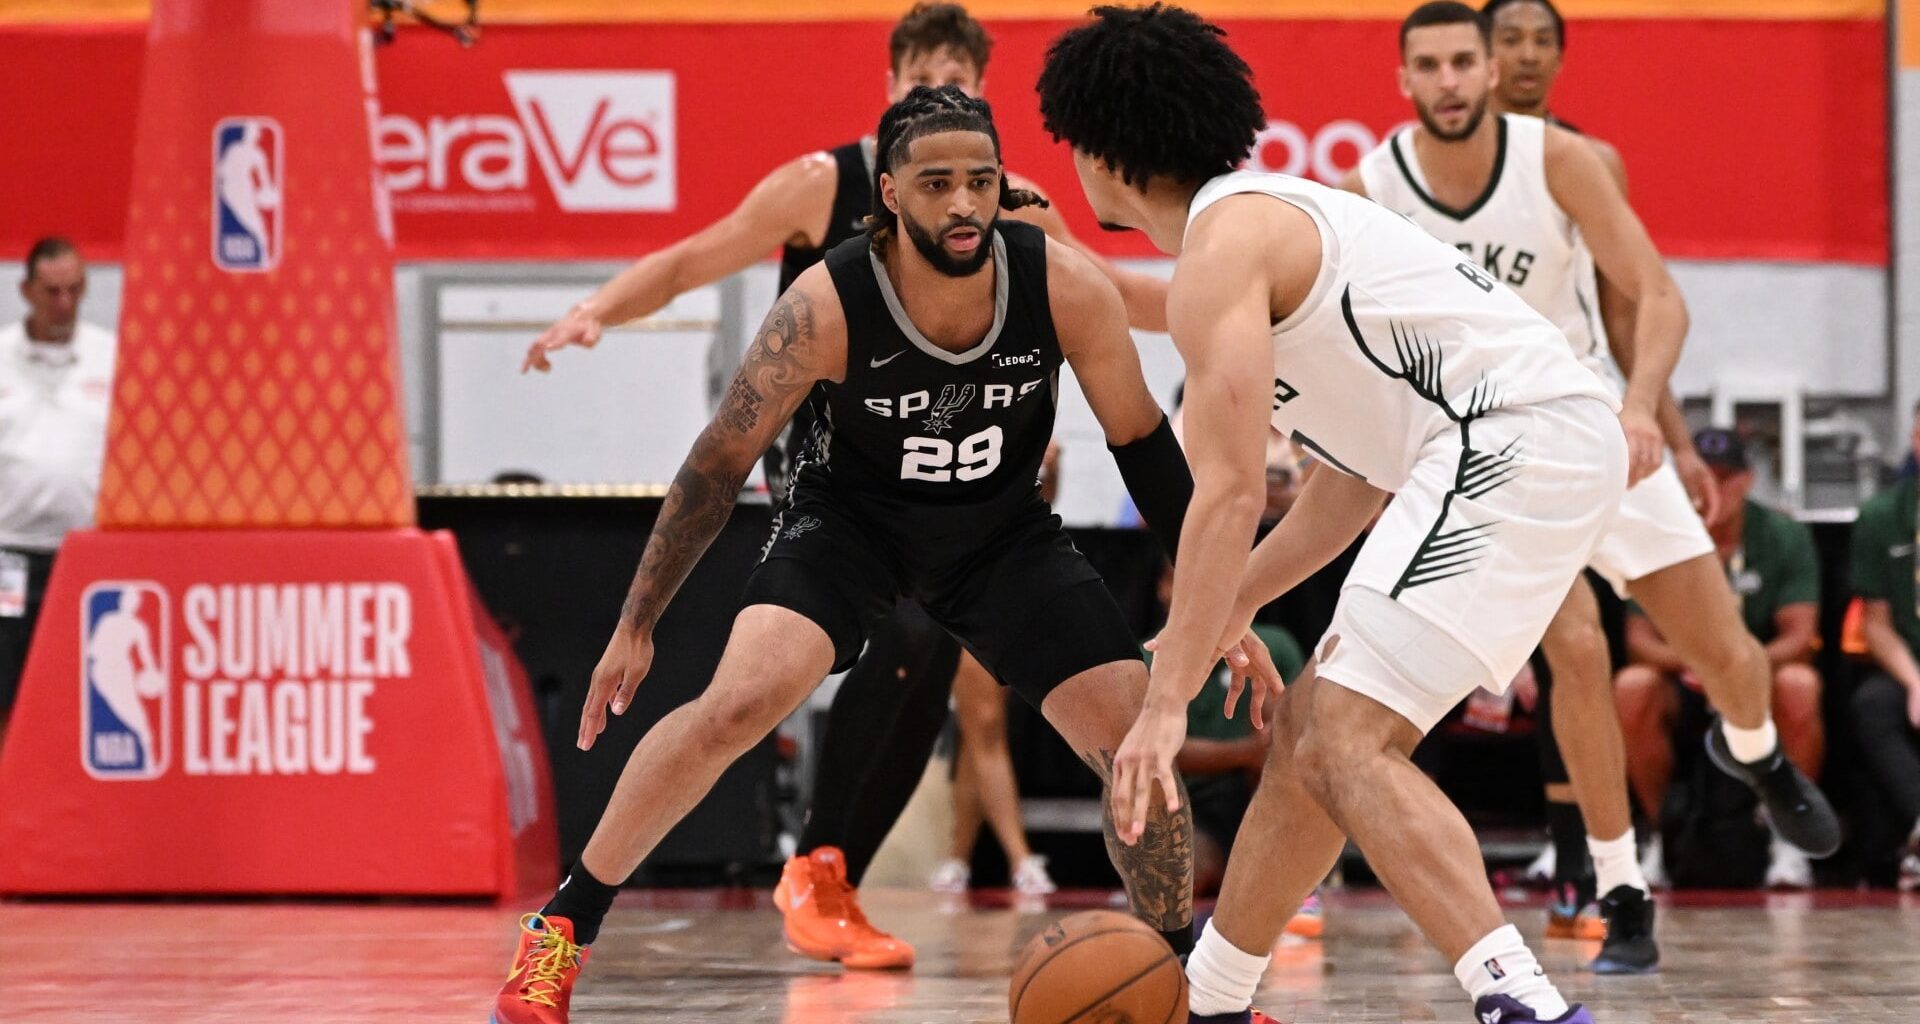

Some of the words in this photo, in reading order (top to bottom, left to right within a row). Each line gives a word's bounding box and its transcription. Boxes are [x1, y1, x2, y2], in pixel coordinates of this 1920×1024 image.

[375, 98, 660, 191] eraVe
[900, 425, 1003, 483] 29
[182, 582, 412, 681] SUMMER
[183, 680, 376, 776] LEAGUE
